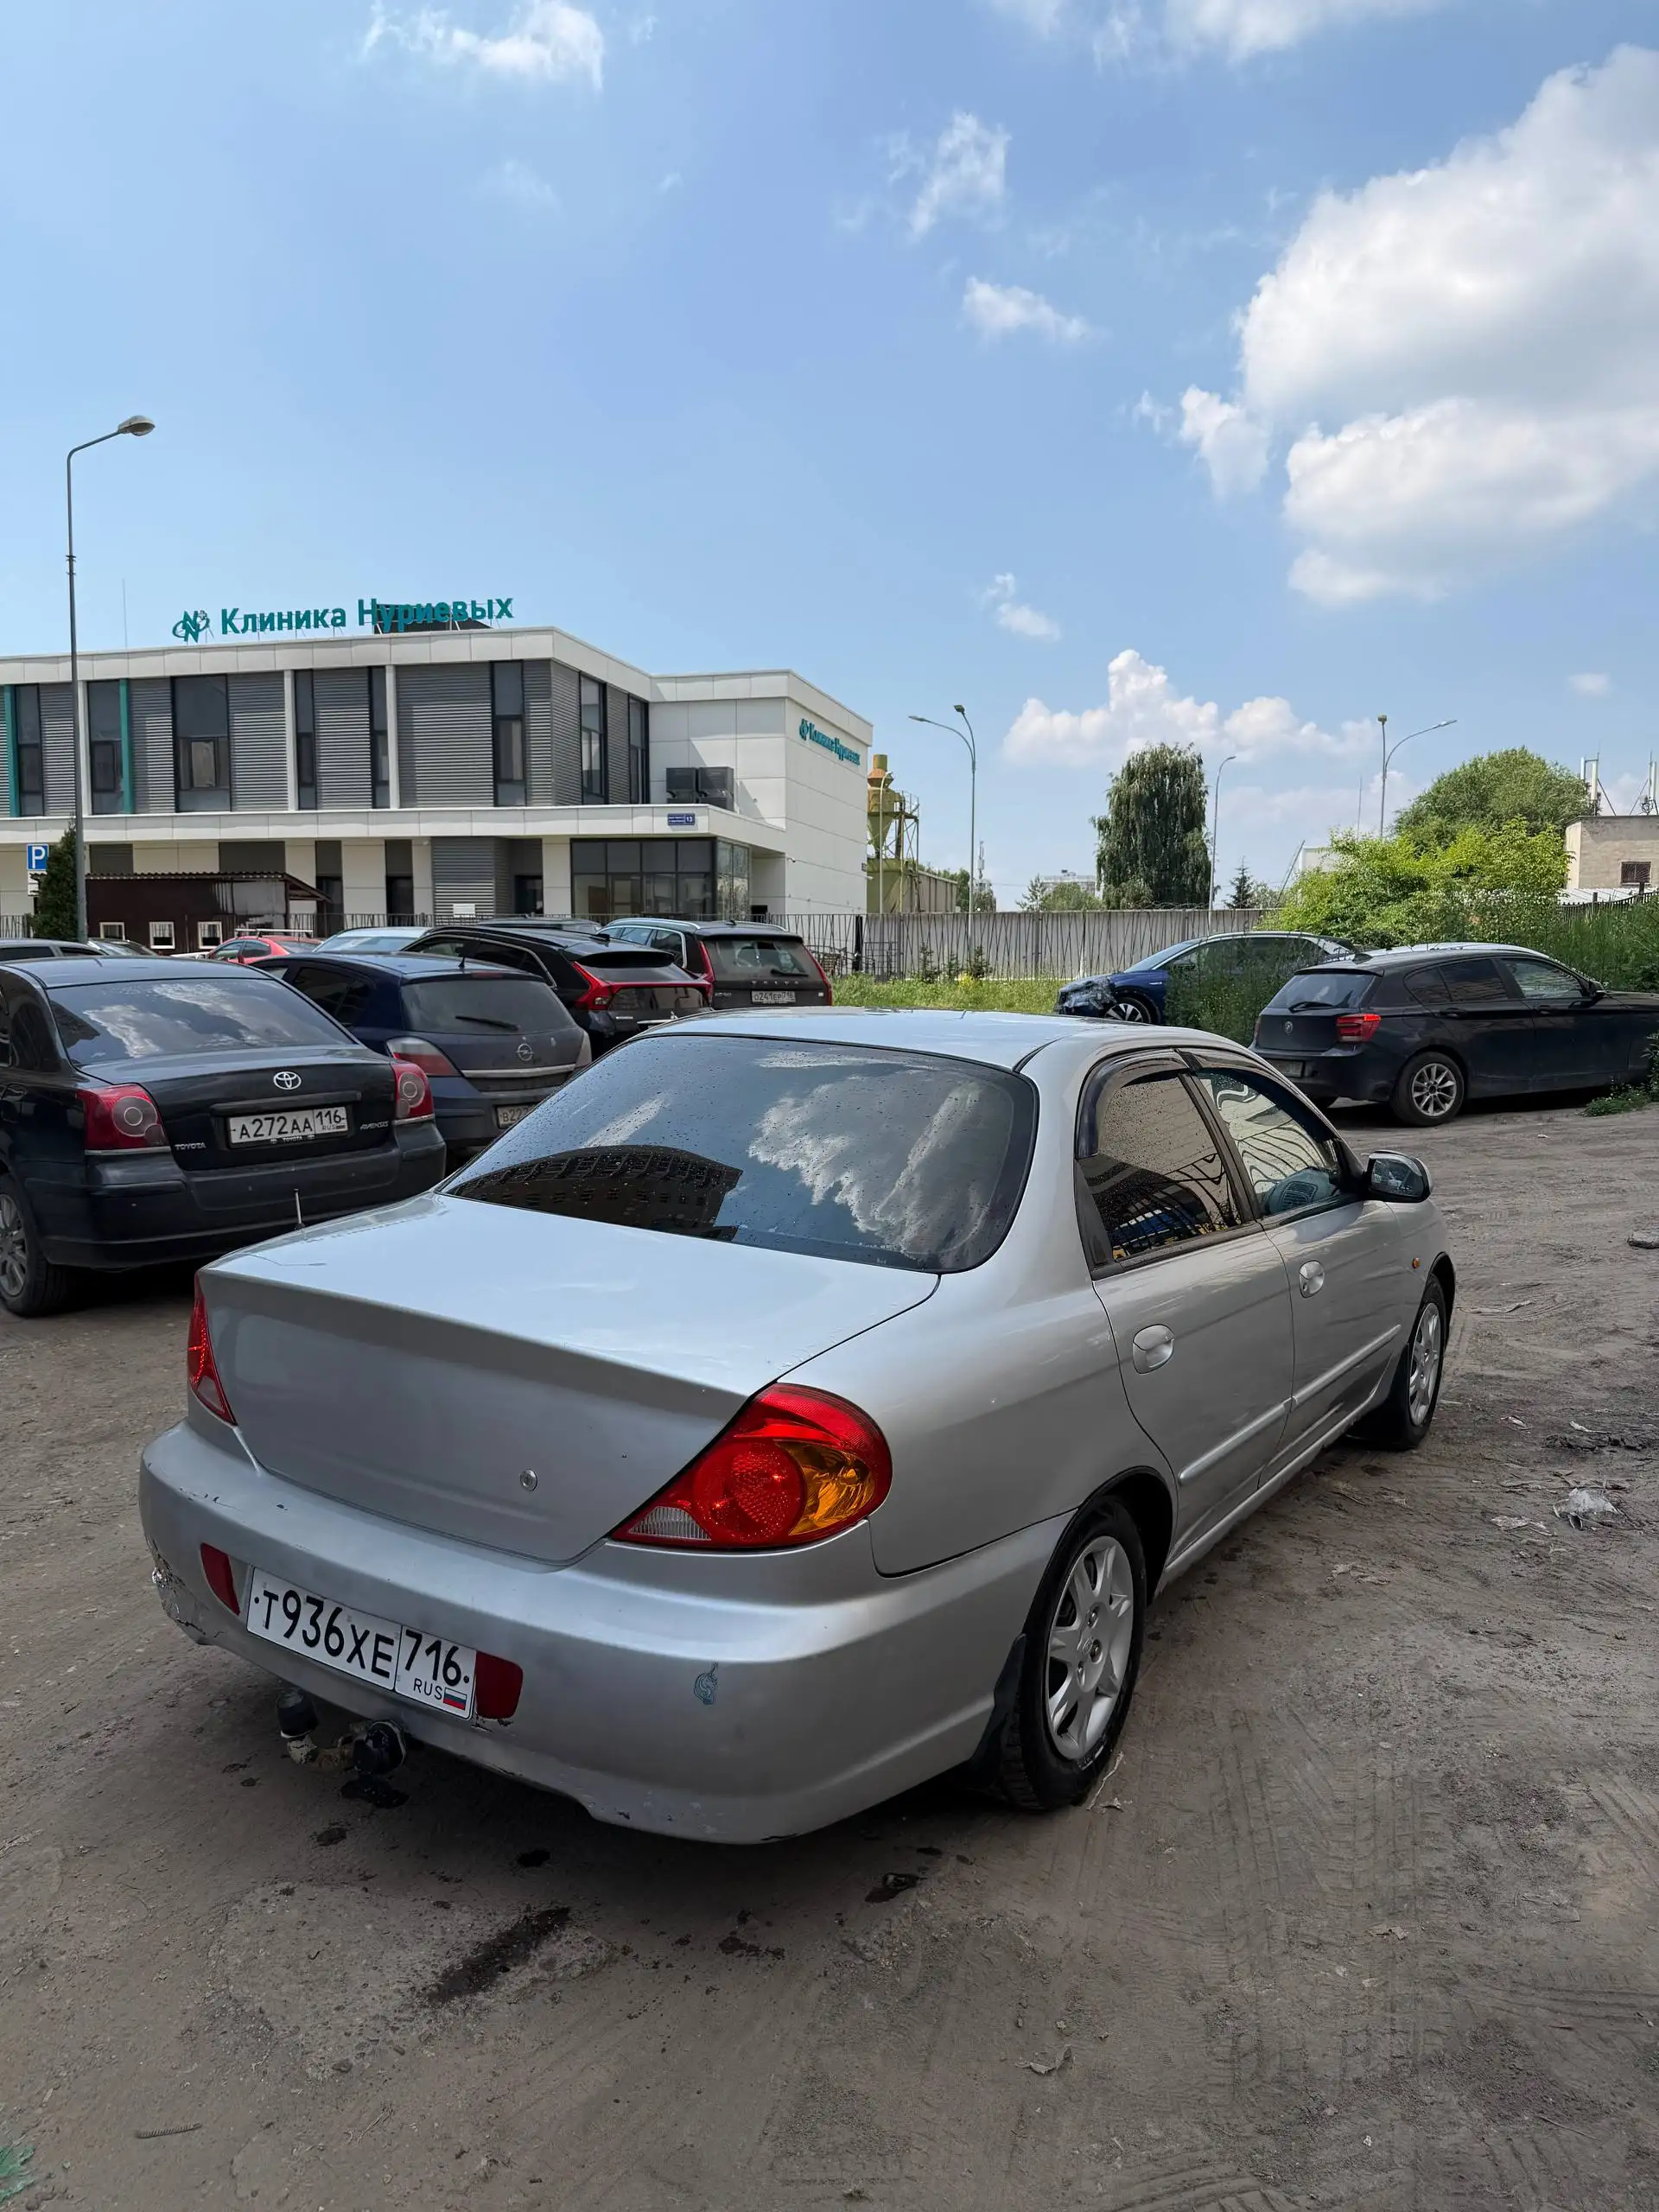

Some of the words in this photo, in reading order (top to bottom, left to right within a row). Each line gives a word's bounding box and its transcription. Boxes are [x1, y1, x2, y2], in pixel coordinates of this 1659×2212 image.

[221, 607, 346, 635] Клиника
[358, 598, 514, 632] Нуриевых
[32, 846, 45, 868] P
[239, 1116, 313, 1139] А272АА
[315, 1109, 342, 1125] 116
[174, 1141, 207, 1151] TOYOTA
[262, 1589, 395, 1678] Т936ХЕ
[404, 1629, 462, 1687] 716
[413, 1678, 443, 1700] RUS
